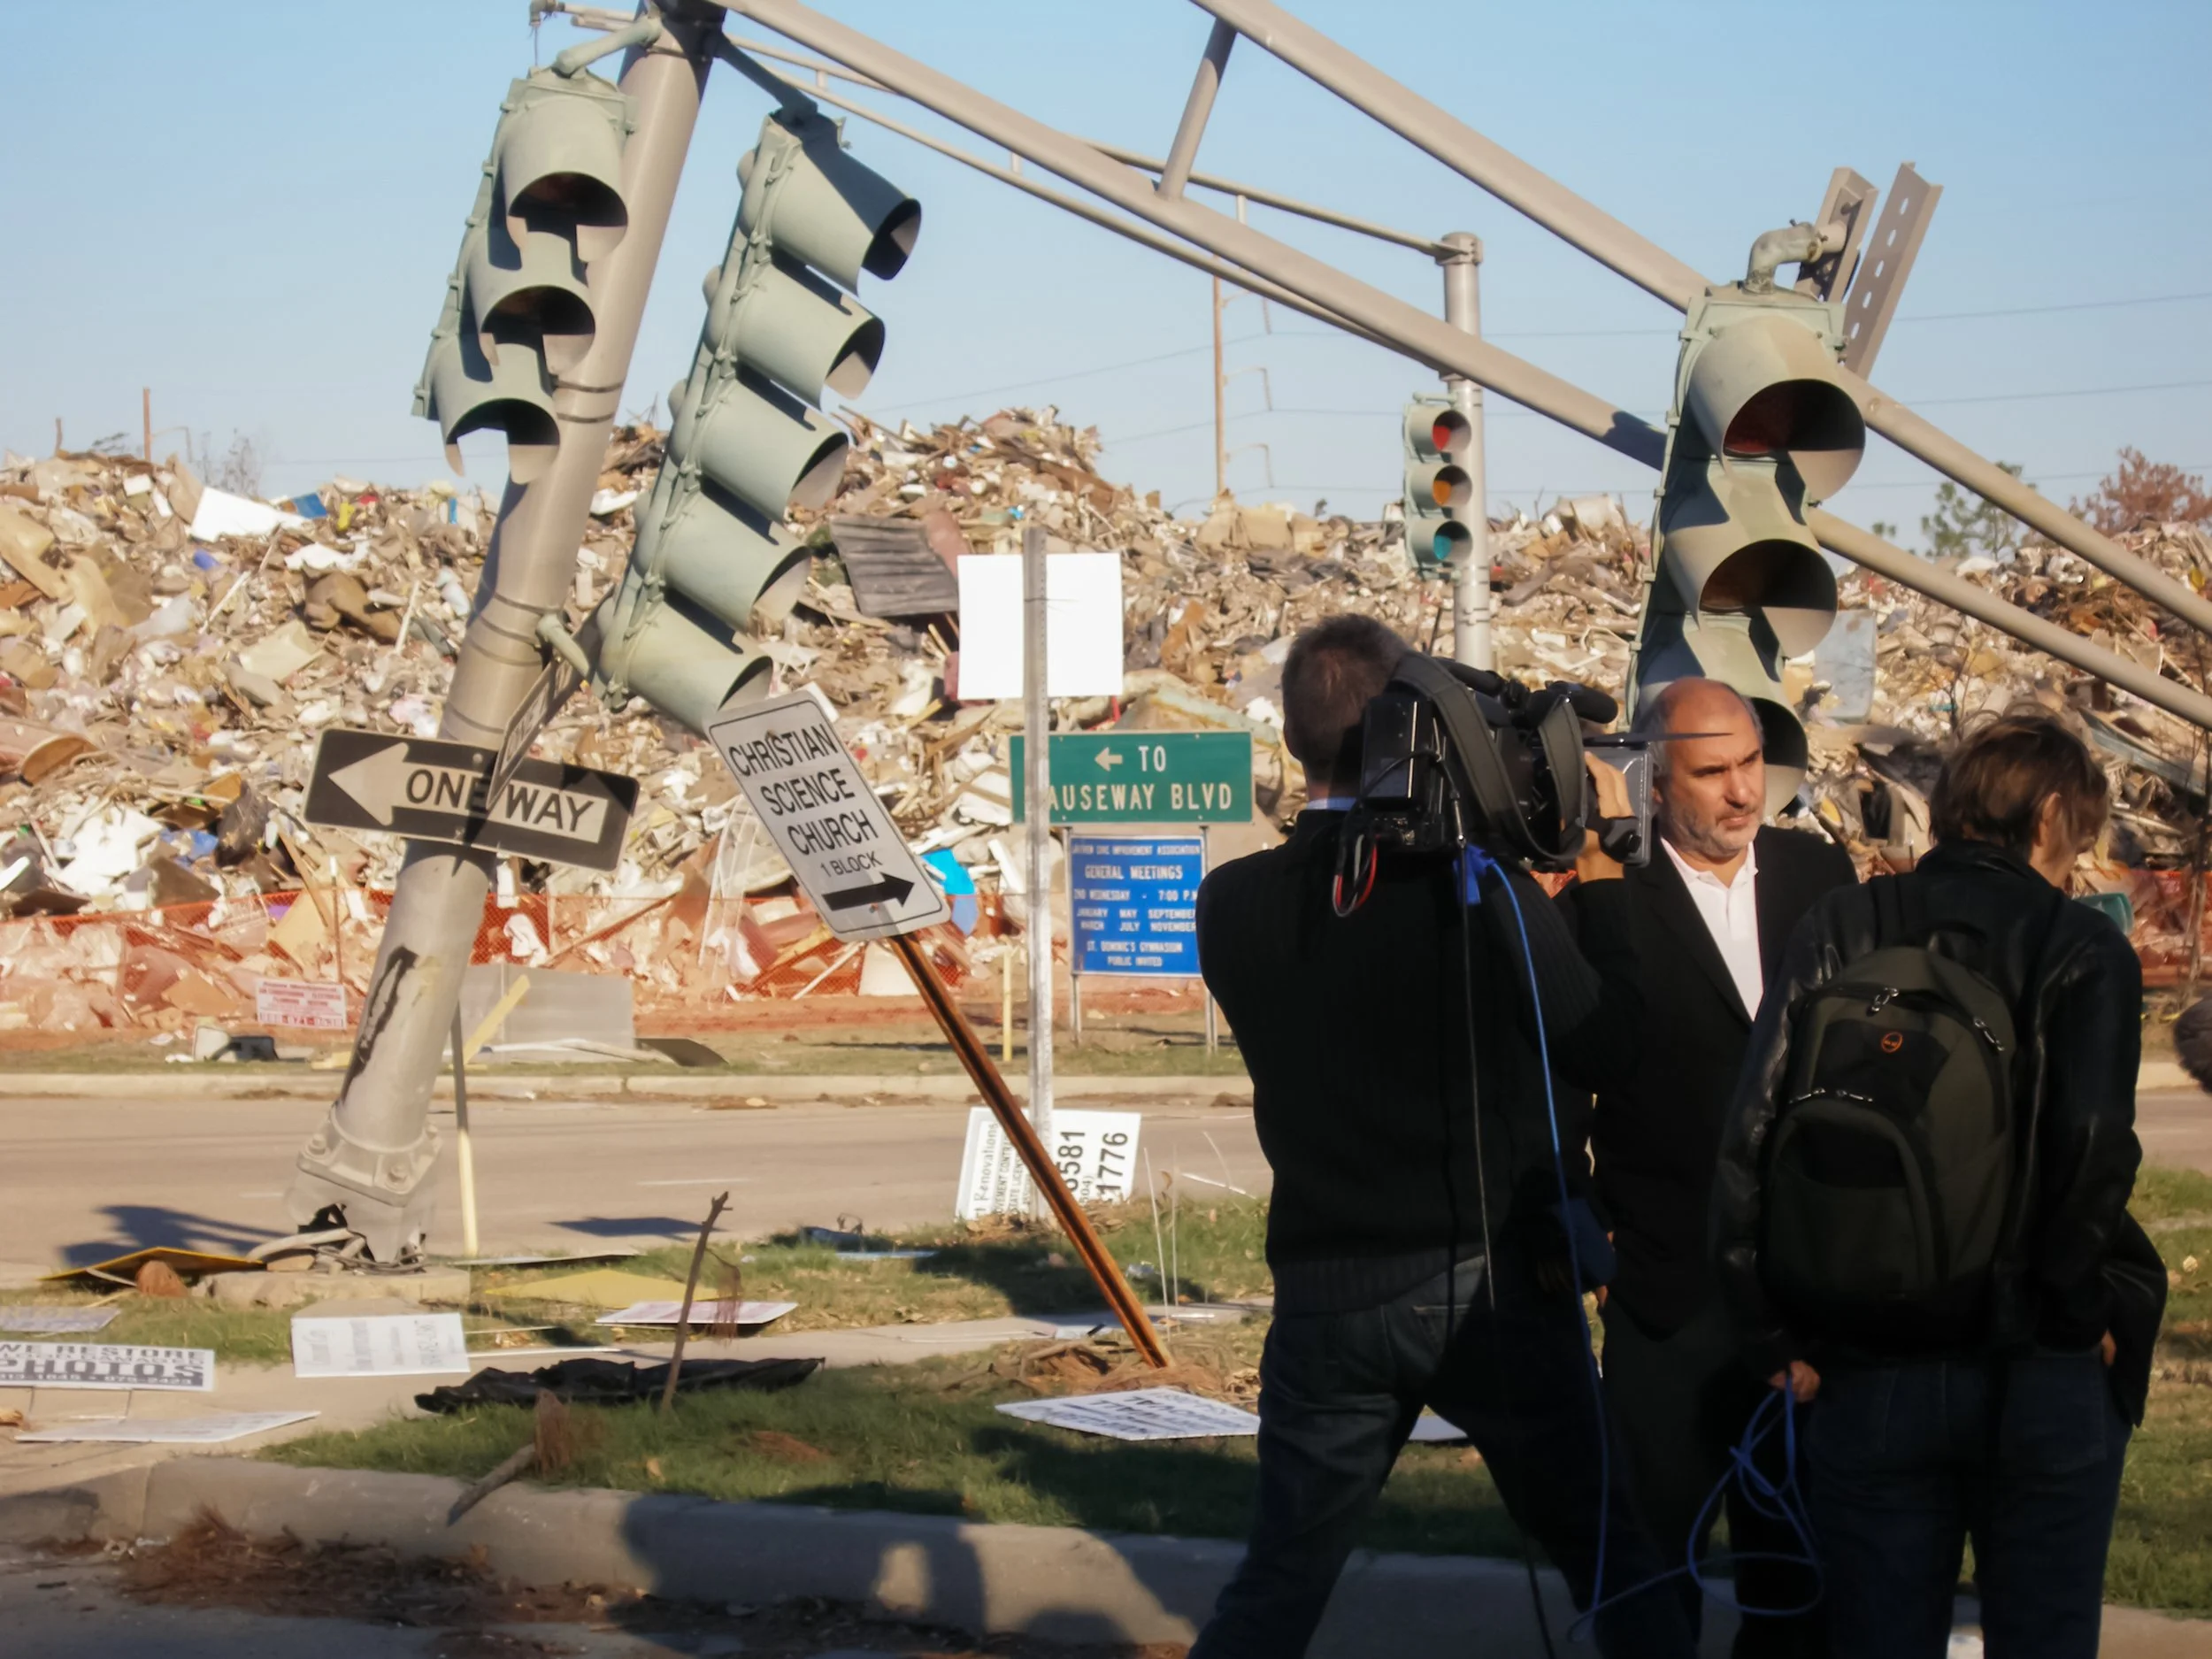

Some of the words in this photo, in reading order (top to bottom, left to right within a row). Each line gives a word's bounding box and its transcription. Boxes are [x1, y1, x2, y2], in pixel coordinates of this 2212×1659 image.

[728, 724, 839, 777] CHRISTIAN
[1138, 746, 1166, 772] TO
[406, 769, 488, 811] ONE
[505, 784, 595, 832] WAY
[760, 768, 856, 816] SCIENCE
[1049, 784, 1155, 810] AUSEWAY
[1171, 783, 1232, 810] BLVD
[787, 809, 879, 856] CHURCH
[820, 863, 832, 878] 1
[830, 851, 883, 875] BLOCK
[1085, 865, 1124, 879] GENERAL
[1130, 865, 1183, 879] MEETINGS
[1158, 889, 1179, 901] 7:00
[1119, 922, 1140, 932] JULY
[974, 1121, 998, 1202] Renovations
[1012, 1154, 1024, 1185] LICENS
[1097, 1133, 1128, 1194] 1776
[995, 1175, 1007, 1214] OVEMENT
[56, 1345, 204, 1359] RESTORE
[0, 1359, 204, 1380] PHOTOS
